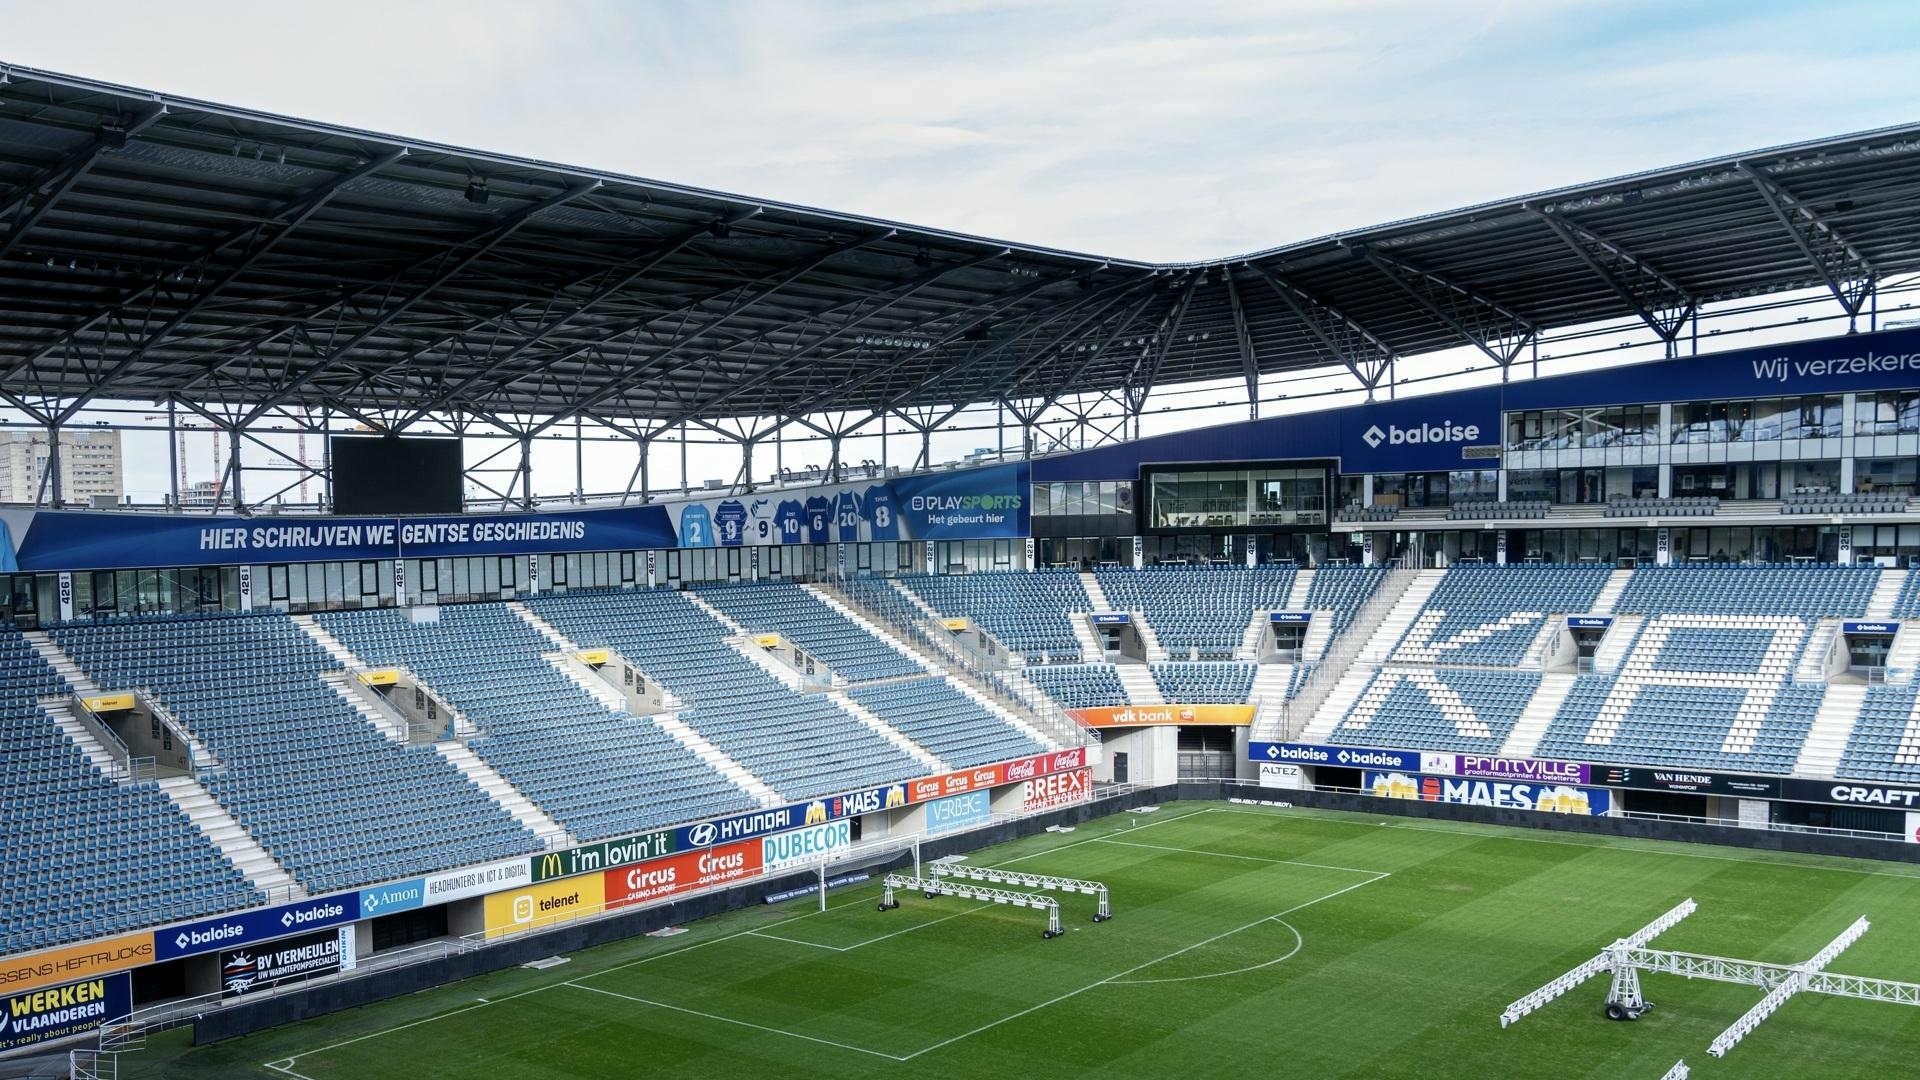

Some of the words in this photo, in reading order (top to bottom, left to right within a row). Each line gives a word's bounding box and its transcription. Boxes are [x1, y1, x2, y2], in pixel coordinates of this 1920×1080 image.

[1752, 357, 1789, 382] Wij
[1794, 351, 1920, 376] verzekere
[1389, 420, 1480, 445] baloise
[783, 518, 799, 534] 10
[813, 514, 823, 531] 6
[840, 511, 857, 527] 20
[875, 506, 891, 528] 8
[928, 514, 945, 524] Het
[947, 514, 984, 526] gebeurt
[985, 513, 1005, 523] hier
[200, 527, 248, 550] HIER
[252, 525, 361, 548] SCHRIJVEN
[365, 525, 395, 545] WE
[401, 523, 470, 544] GENTSE
[472, 521, 585, 542] GESCHIEDENIS
[690, 522, 701, 543] 2
[758, 520, 769, 538] 9
[1112, 710, 1137, 722] vdk
[1139, 709, 1173, 722] bank
[1281, 746, 1329, 761] baloise
[1352, 752, 1402, 767] baloise
[946, 776, 968, 788] Circus
[974, 770, 995, 782] Circus
[1261, 766, 1298, 776] ALTEZ
[1464, 768, 1534, 780] grootformaatprinten
[1542, 774, 1581, 784] belettering
[1654, 772, 1673, 781] VAN
[1674, 773, 1712, 785] HENDE
[916, 781, 939, 794] Circus
[1023, 769, 1082, 801] BREEX
[1443, 778, 1533, 810] MAES
[1830, 785, 1920, 806] CRAFT
[842, 789, 880, 816] MAES
[933, 793, 982, 822] VERBEKE
[721, 810, 790, 839] HYUNDAI
[571, 849, 600, 873] i'm
[604, 835, 652, 864] lovin'
[655, 833, 667, 855] it
[764, 822, 849, 864] DUBECOR
[698, 851, 744, 874] Circus
[429, 873, 476, 895] HEADHUNTERS
[477, 871, 485, 885] IN
[486, 870, 497, 883] ICT
[497, 868, 503, 881] &
[504, 863, 528, 880] DIGITAL
[627, 866, 676, 890] Circus
[380, 887, 419, 906] Amon
[539, 891, 580, 912] telenet
[295, 903, 344, 924] baloise
[191, 923, 244, 945] baloise
[56, 943, 153, 973] HEFTRUCKS
[257, 954, 273, 971] BV
[275, 939, 339, 966] VERMEULEN
[257, 970, 269, 980] UW
[269, 954, 339, 978] WARMTEPOMPSPECIALIST
[11, 979, 105, 1018] WERKEN
[12, 1001, 105, 1033] VLAANDEREN
[16, 1031, 42, 1046] really
[44, 1026, 69, 1039] about
